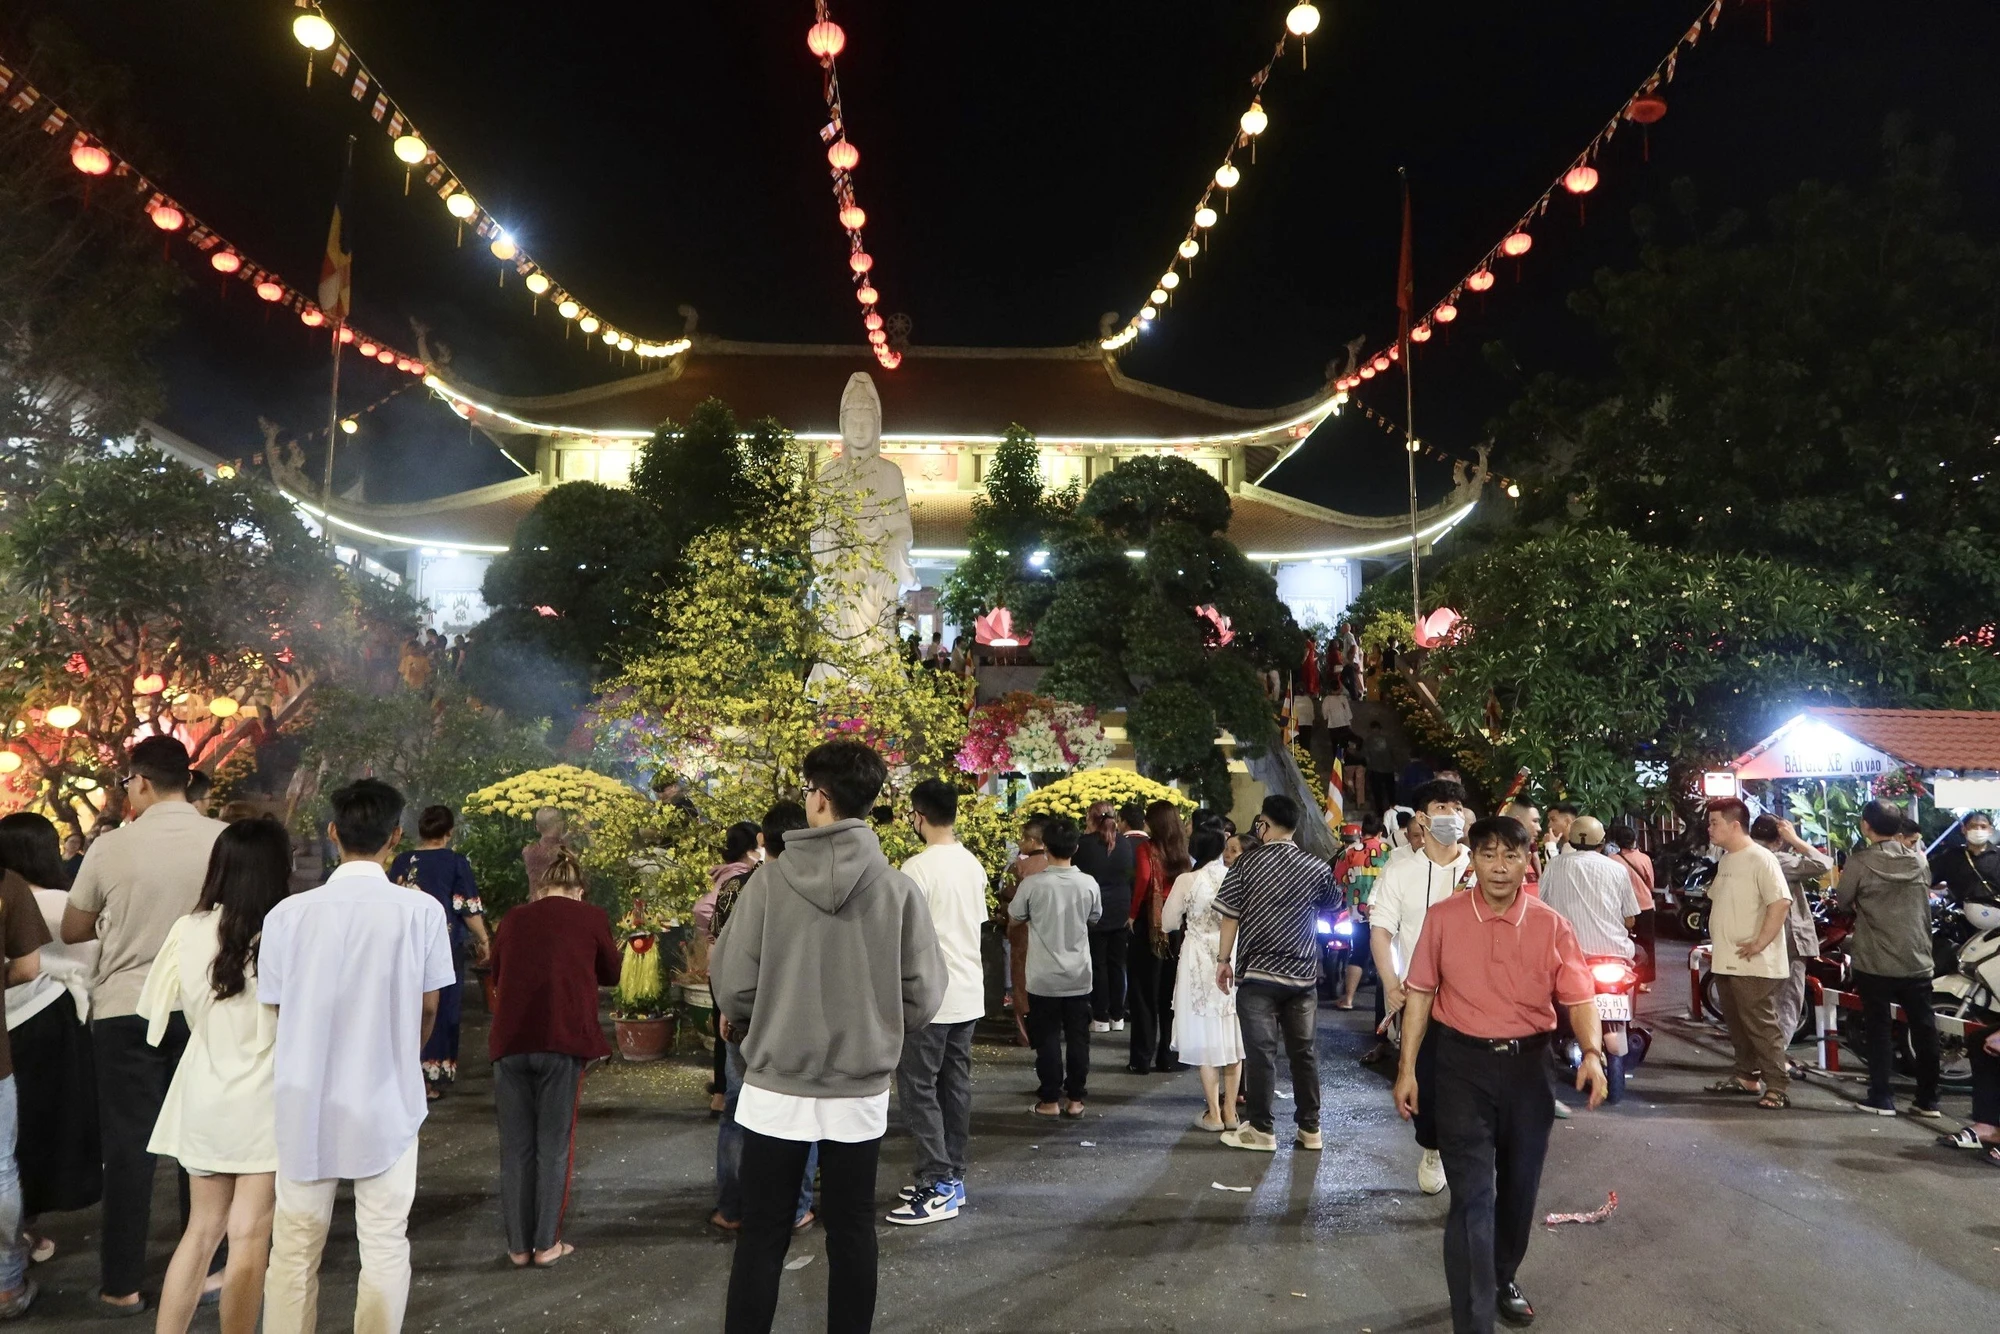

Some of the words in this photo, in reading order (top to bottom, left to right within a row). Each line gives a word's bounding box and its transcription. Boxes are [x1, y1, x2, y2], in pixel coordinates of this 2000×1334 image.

[1827, 752, 1843, 772] XE
[1850, 758, 1864, 773] LỐI
[1865, 757, 1882, 772] VÀO
[1598, 1008, 1628, 1019] 21.77
